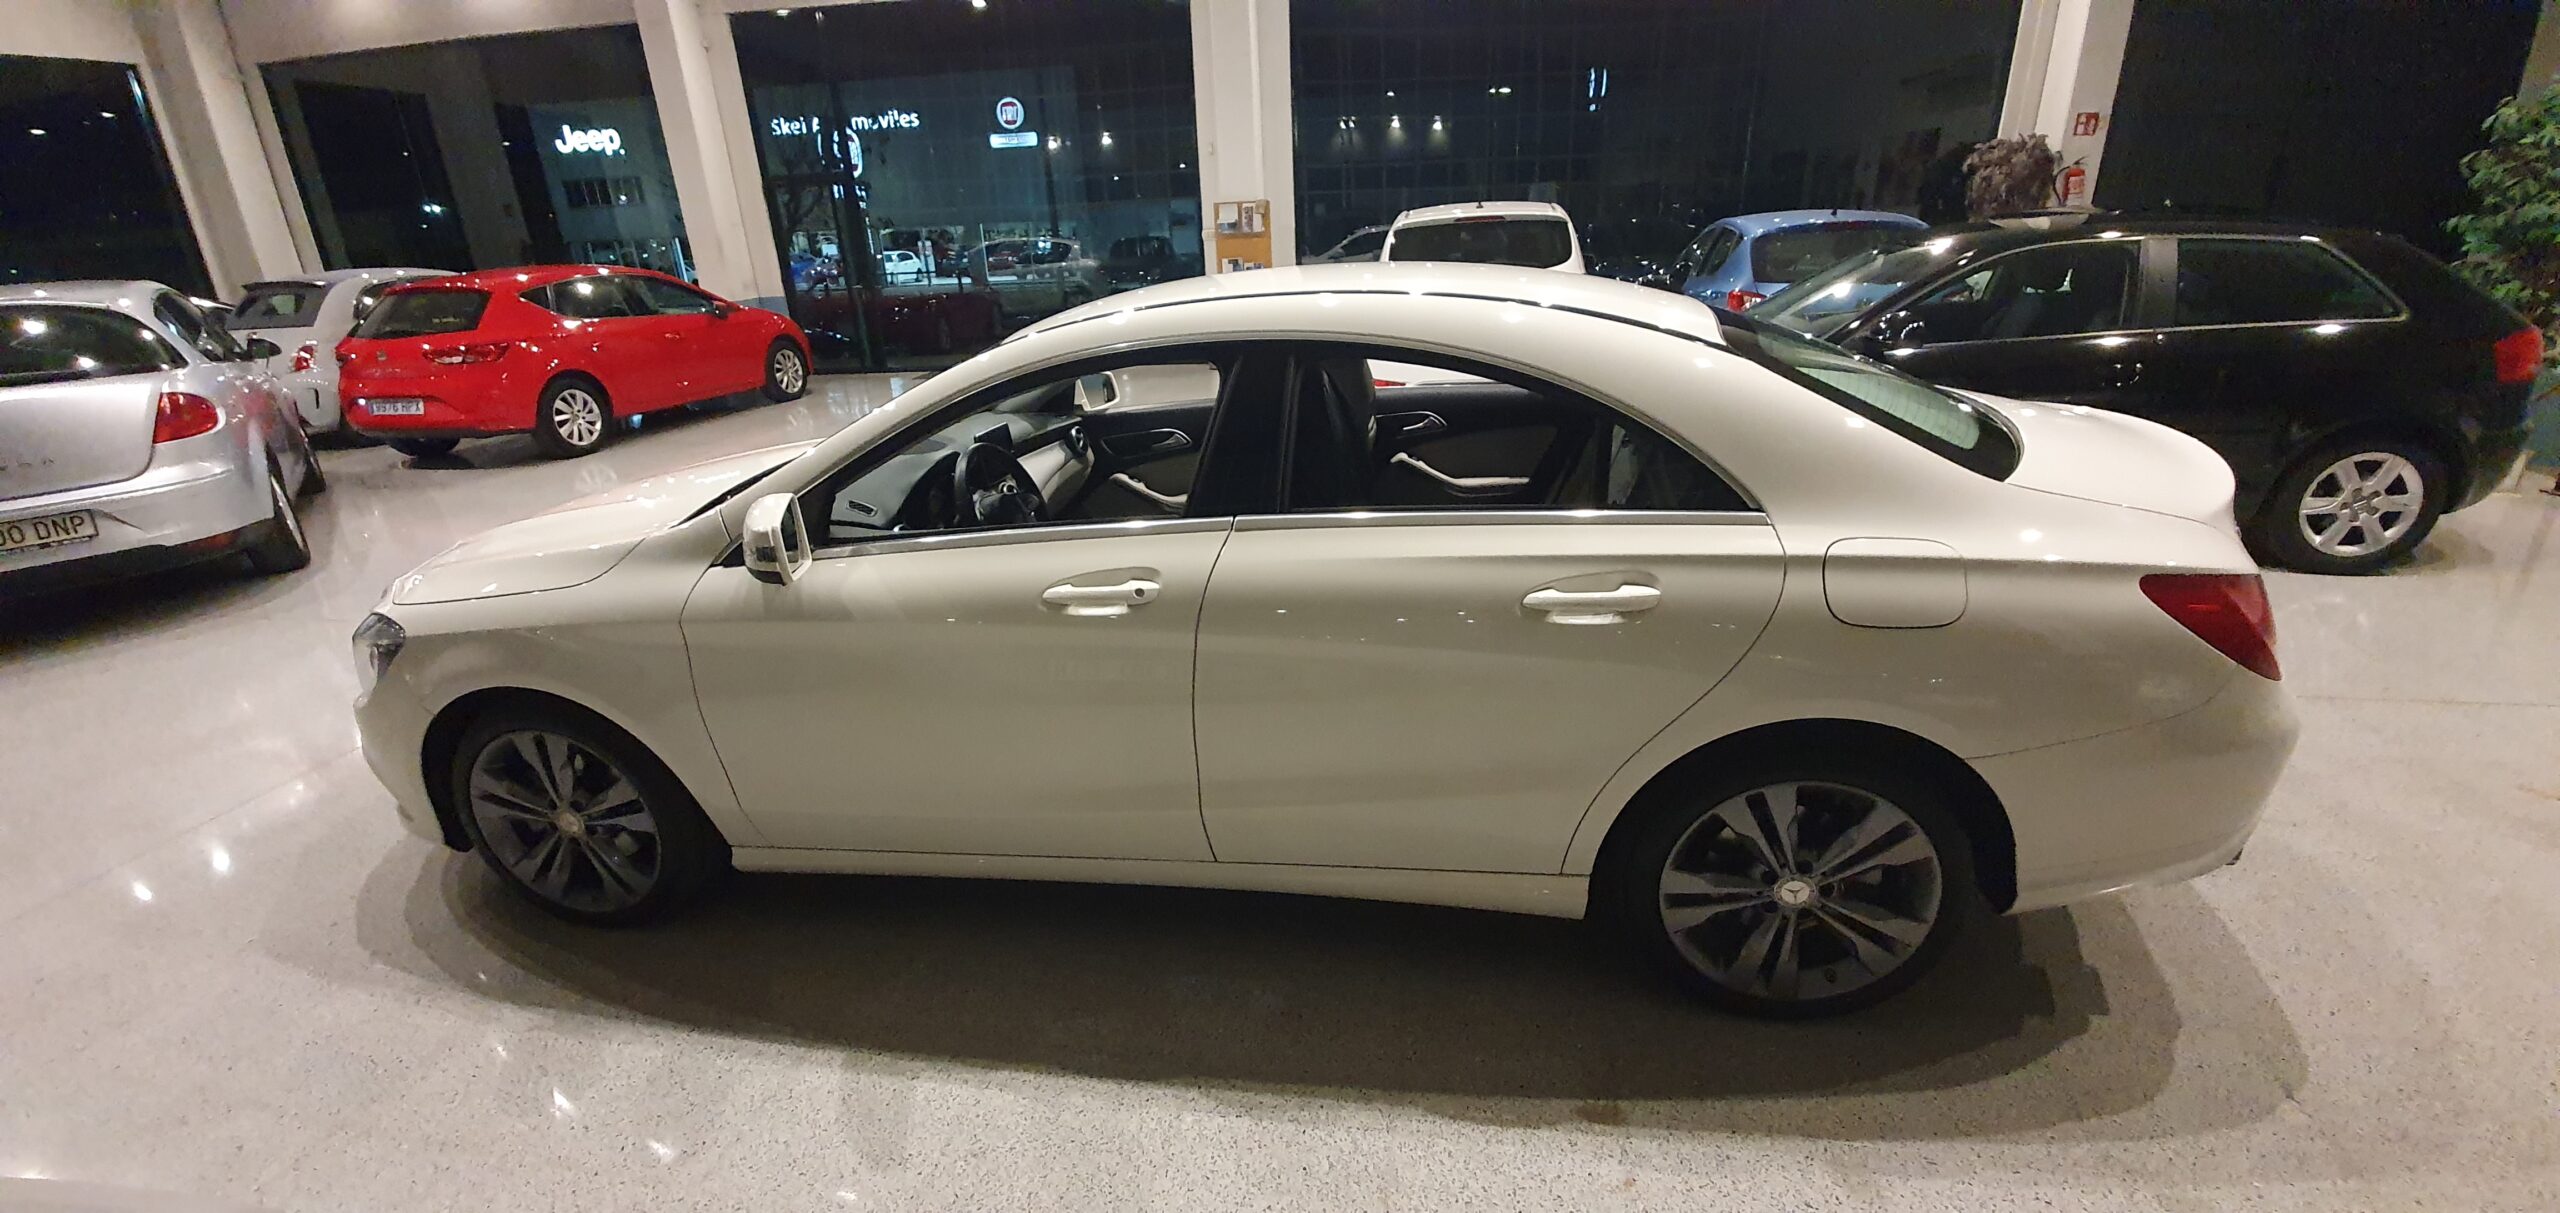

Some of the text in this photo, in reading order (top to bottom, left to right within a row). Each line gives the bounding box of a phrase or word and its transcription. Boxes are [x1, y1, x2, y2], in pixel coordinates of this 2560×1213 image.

[771, 116, 807, 136] Skei
[555, 124, 622, 156] Jeep
[33, 515, 84, 540] DNP
